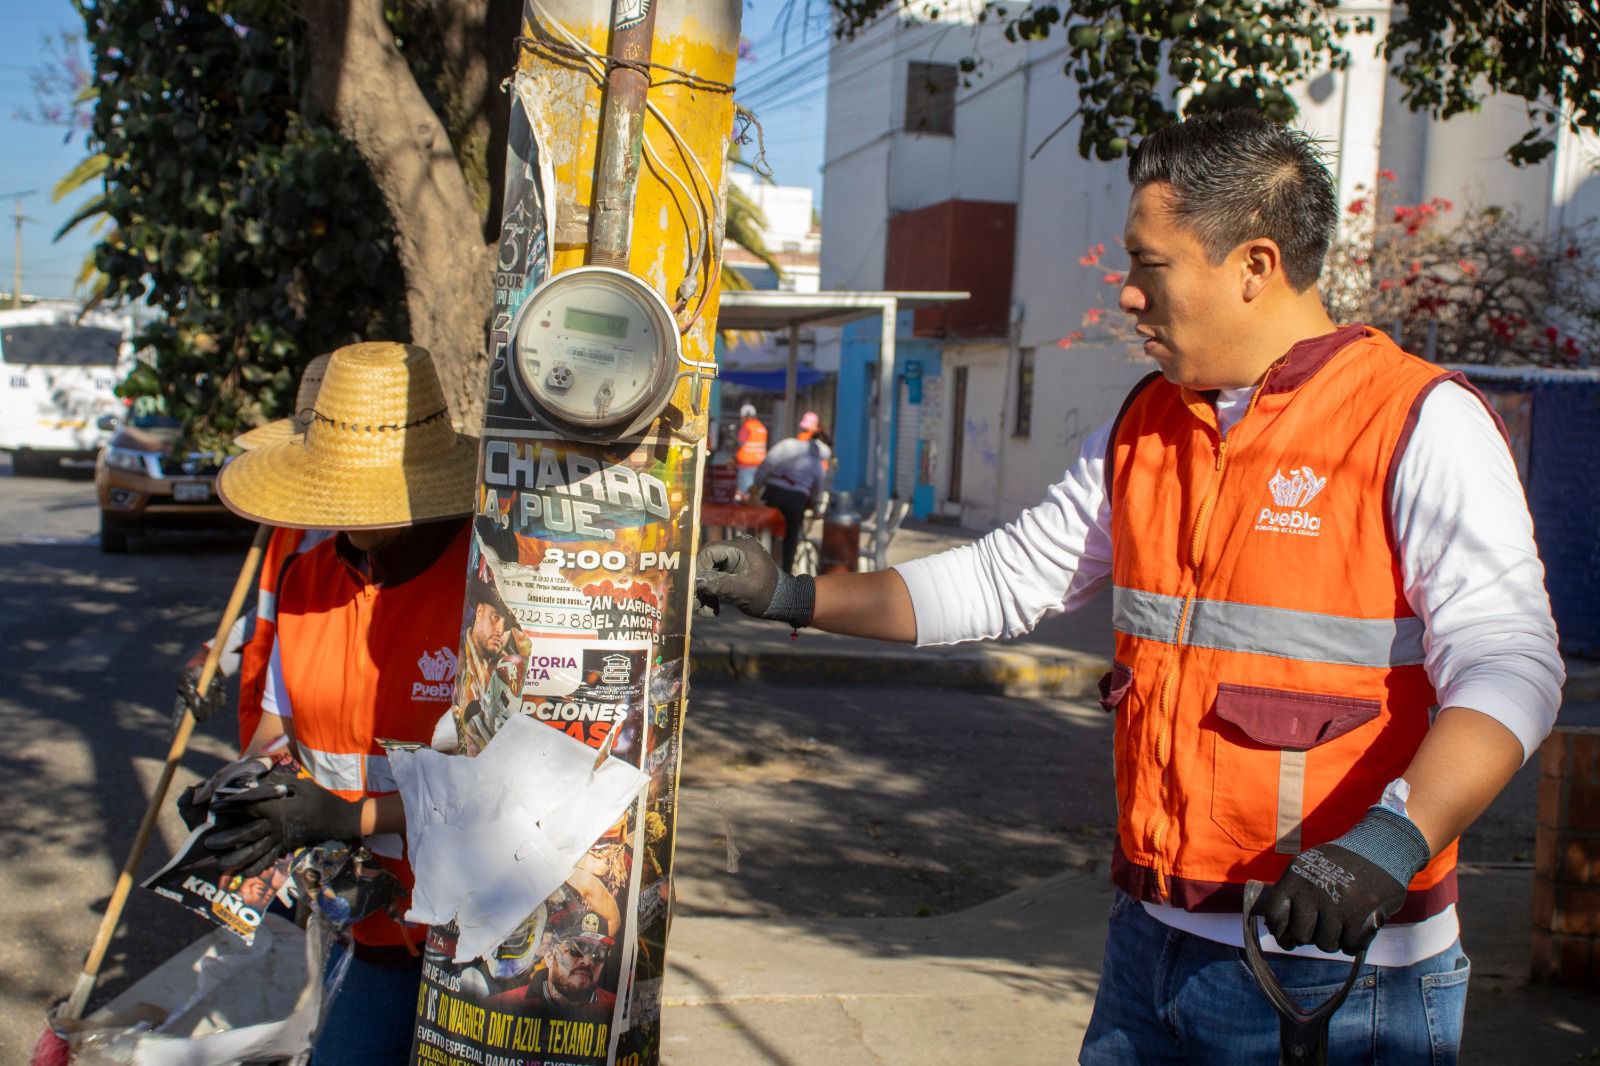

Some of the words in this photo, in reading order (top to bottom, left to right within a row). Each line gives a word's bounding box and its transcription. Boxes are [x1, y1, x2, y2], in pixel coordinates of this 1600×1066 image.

[485, 440, 671, 521] CHARRO
[520, 492, 616, 540] PUE.
[543, 548, 626, 570] 8:00
[639, 551, 681, 571] PM
[617, 598, 662, 620] JARIPEO
[620, 614, 653, 630] AMOR
[182, 875, 262, 927] KRIÑO
[417, 1025, 445, 1049] EVENTO
[445, 1038, 484, 1065] ESPECIAL
[448, 997, 486, 1043] WAGNER
[487, 1012, 514, 1049] DMT
[512, 1017, 542, 1054] AZUL
[548, 1020, 594, 1056] TEXANO
[418, 1042, 448, 1066] JULISSA
